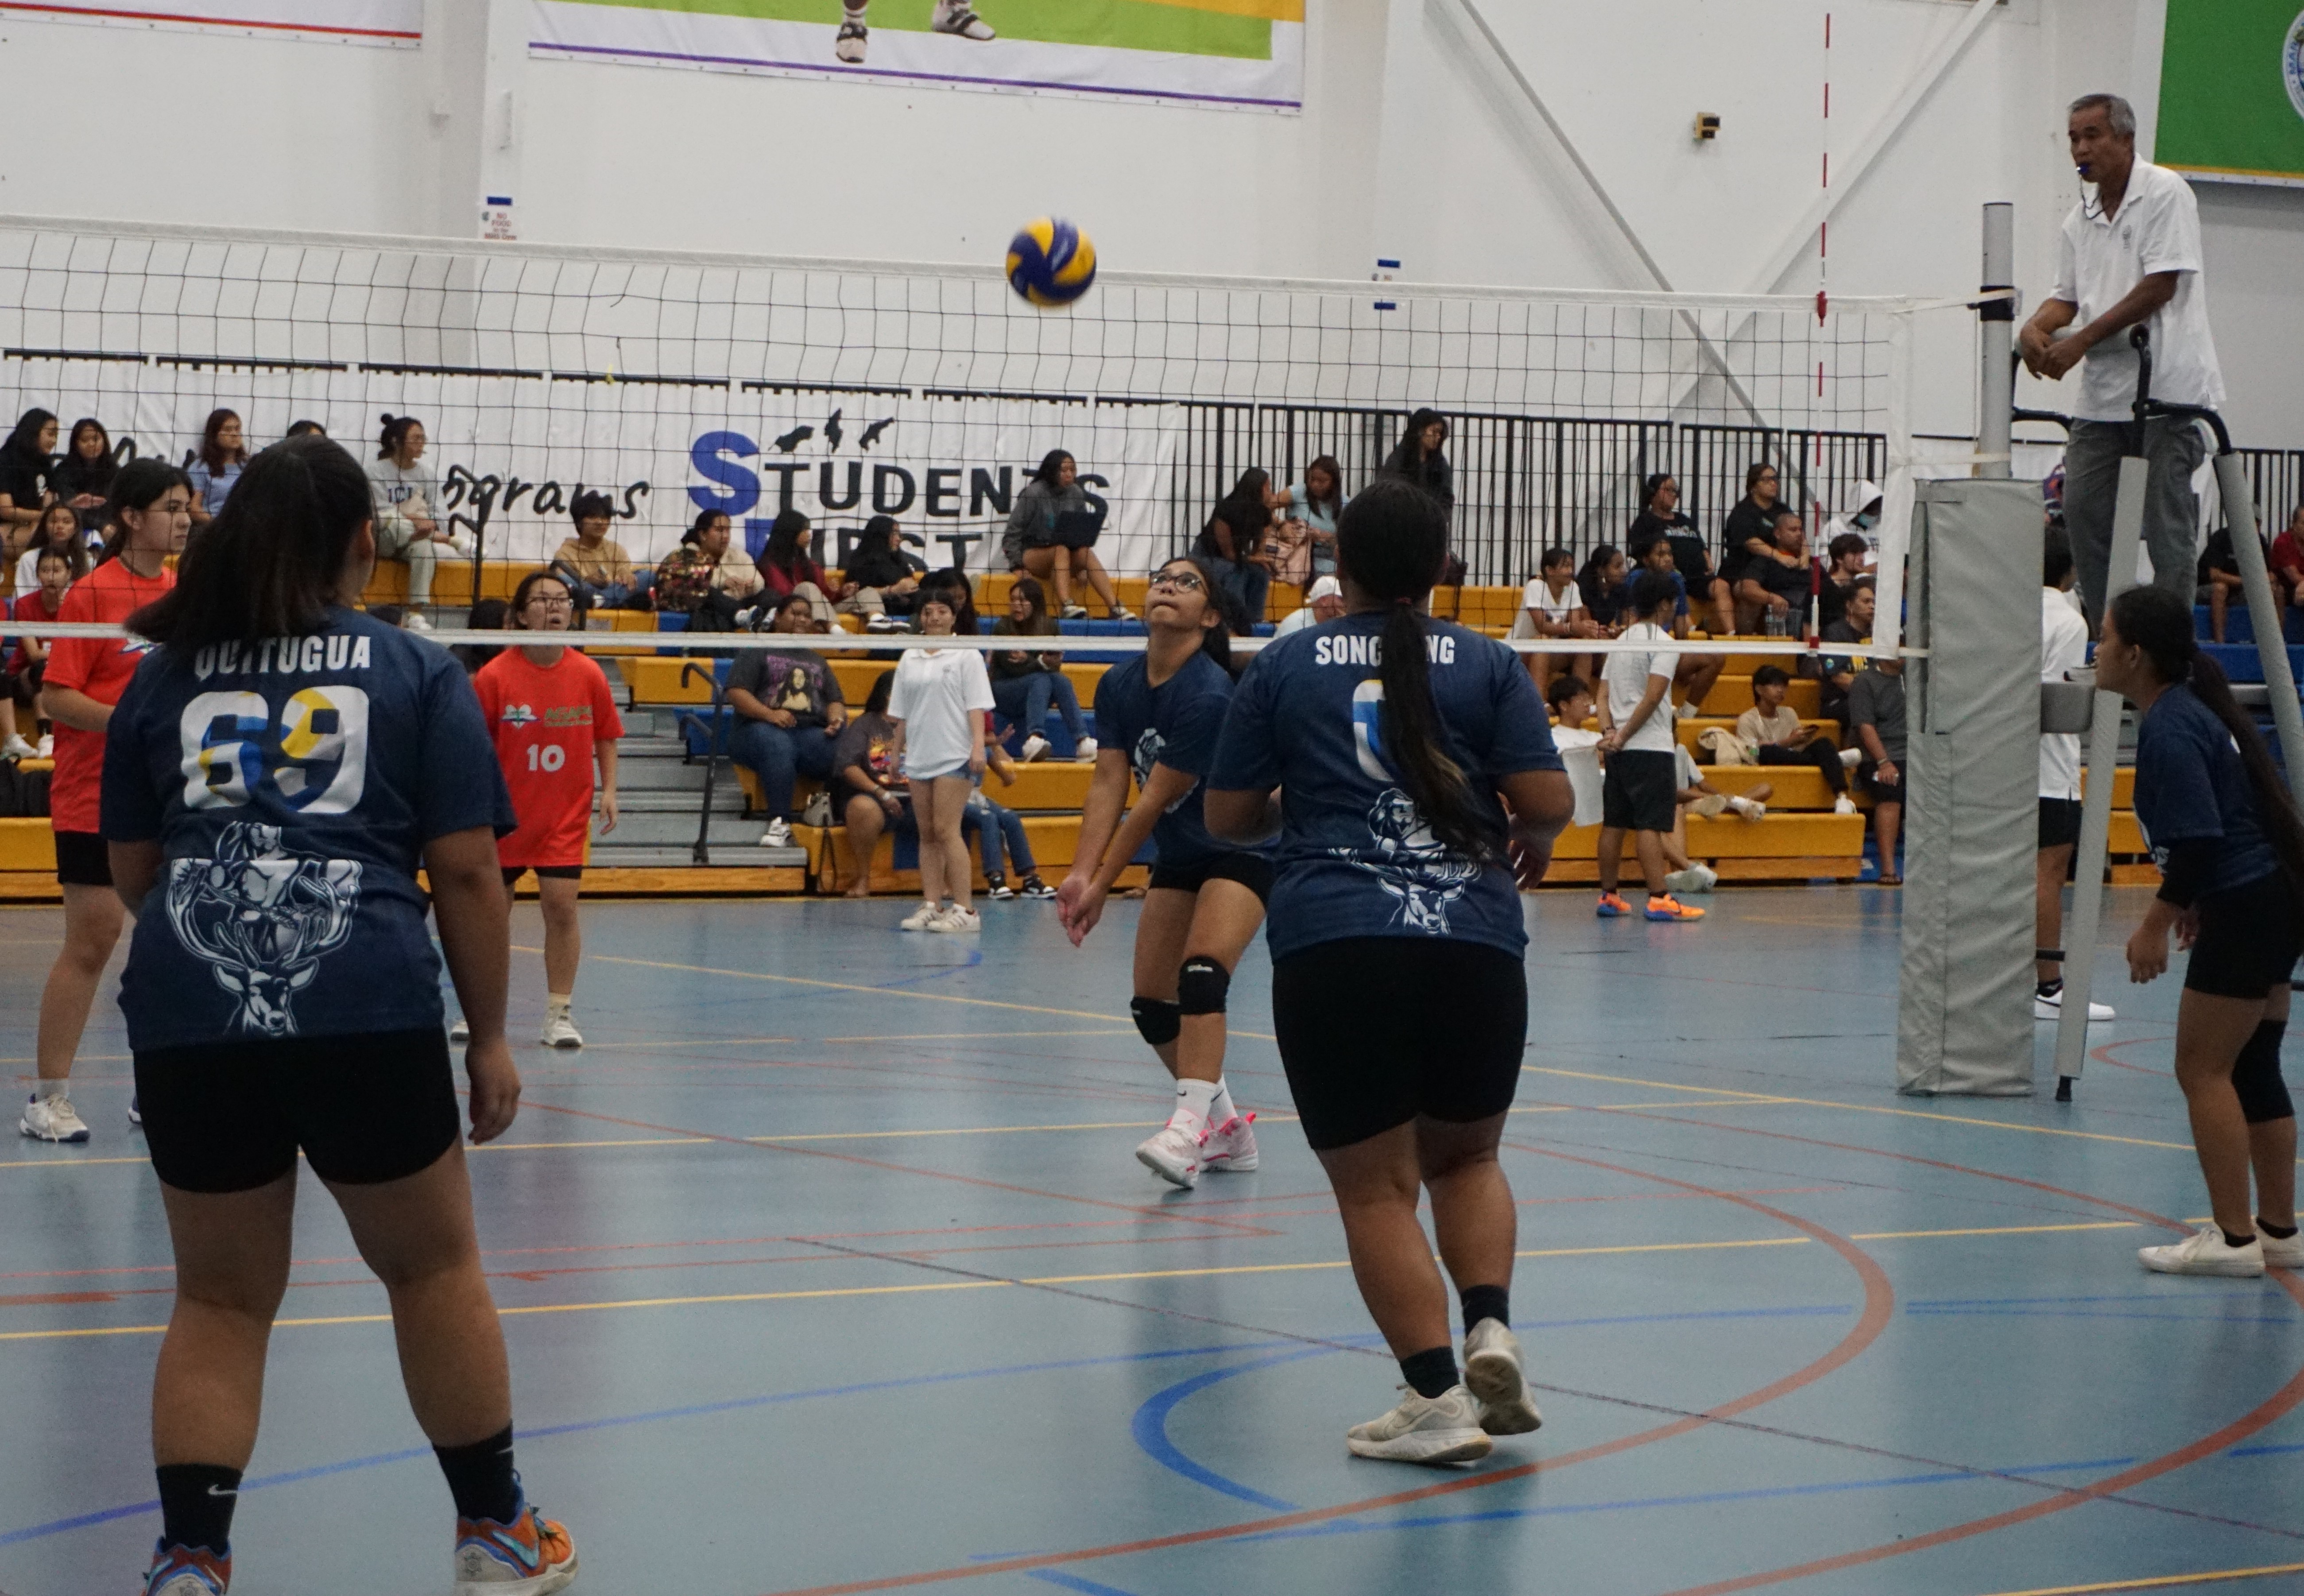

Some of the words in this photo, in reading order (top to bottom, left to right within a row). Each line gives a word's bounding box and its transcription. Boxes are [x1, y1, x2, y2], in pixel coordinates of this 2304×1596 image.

[688, 430, 1110, 517] STUDENS
[194, 635, 371, 682] QUITUGUA
[1315, 634, 1455, 667] SONGNG
[179, 684, 369, 814] 69
[527, 743, 565, 772] 10
